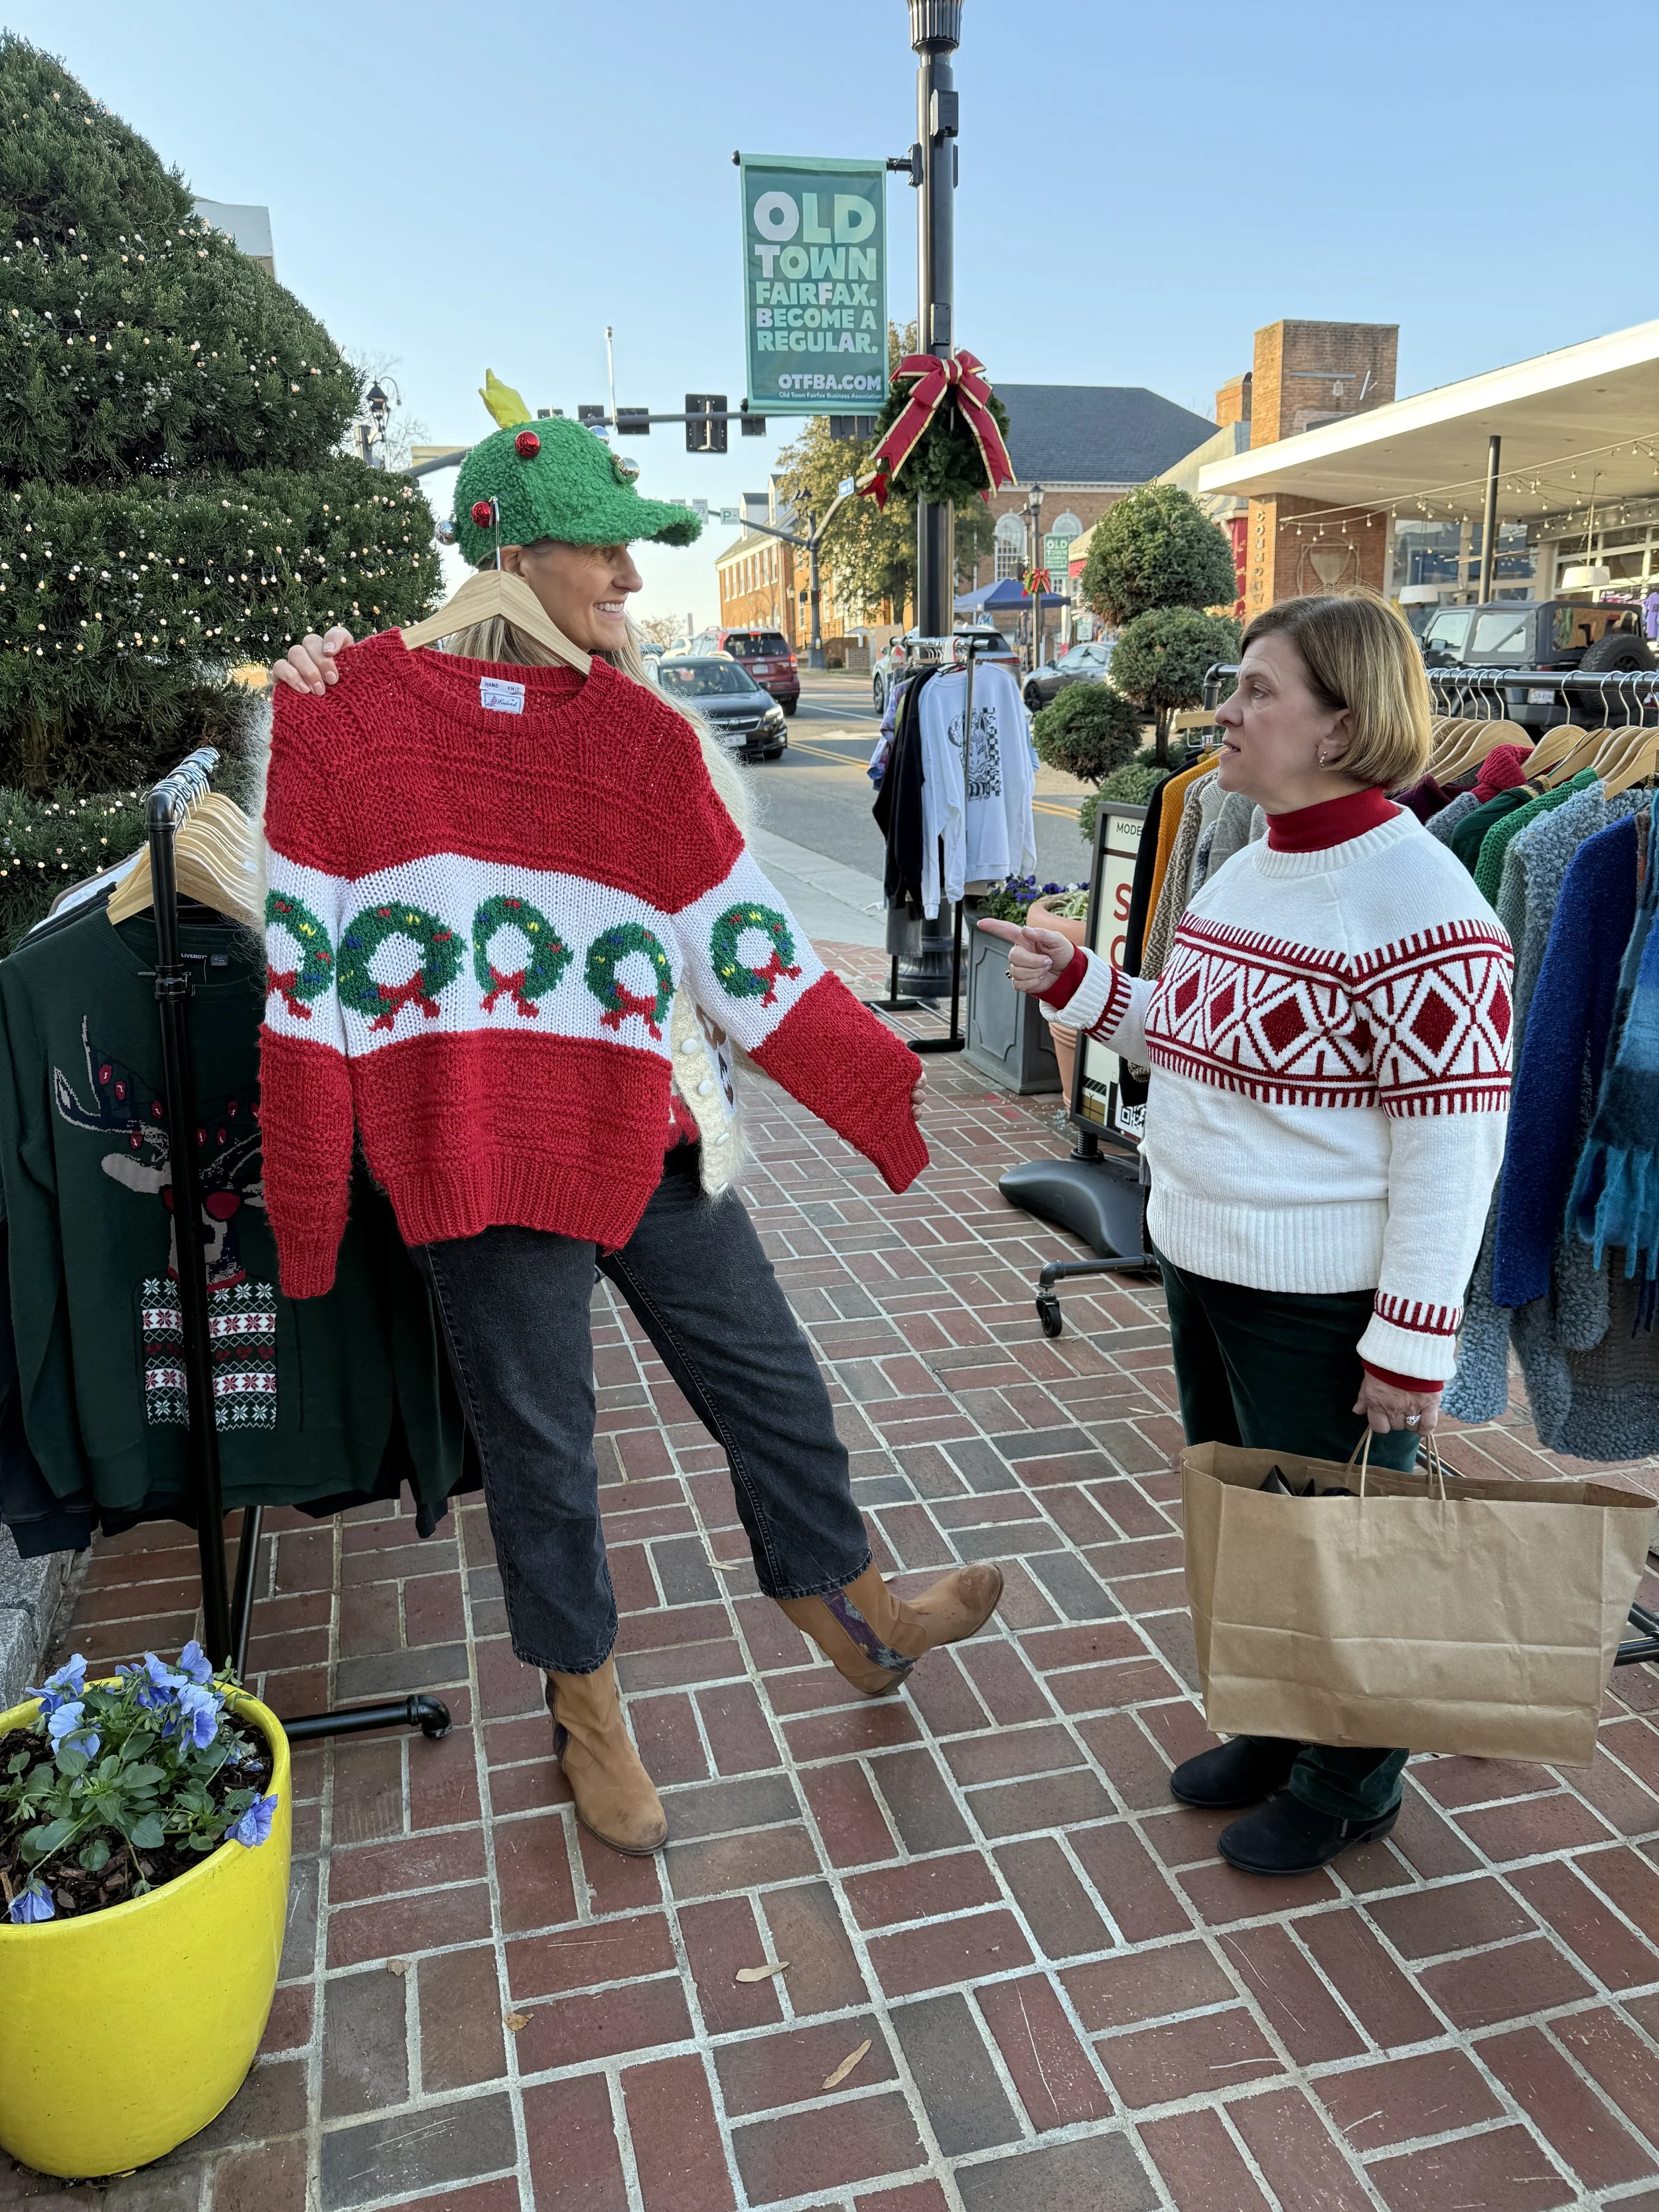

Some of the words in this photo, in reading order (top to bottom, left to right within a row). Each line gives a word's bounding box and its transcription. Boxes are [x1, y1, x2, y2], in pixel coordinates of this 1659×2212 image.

[753, 191, 876, 244] OLD
[755, 244, 877, 281] TOWN
[756, 281, 877, 307] FAIRFAX.
[757, 308, 855, 329] BECOME
[860, 310, 877, 330] A
[757, 331, 878, 354] REGULAR.
[778, 374, 881, 390] OTFBA.COM
[723, 510, 731, 522] P
[1046, 540, 1068, 550] OLD
